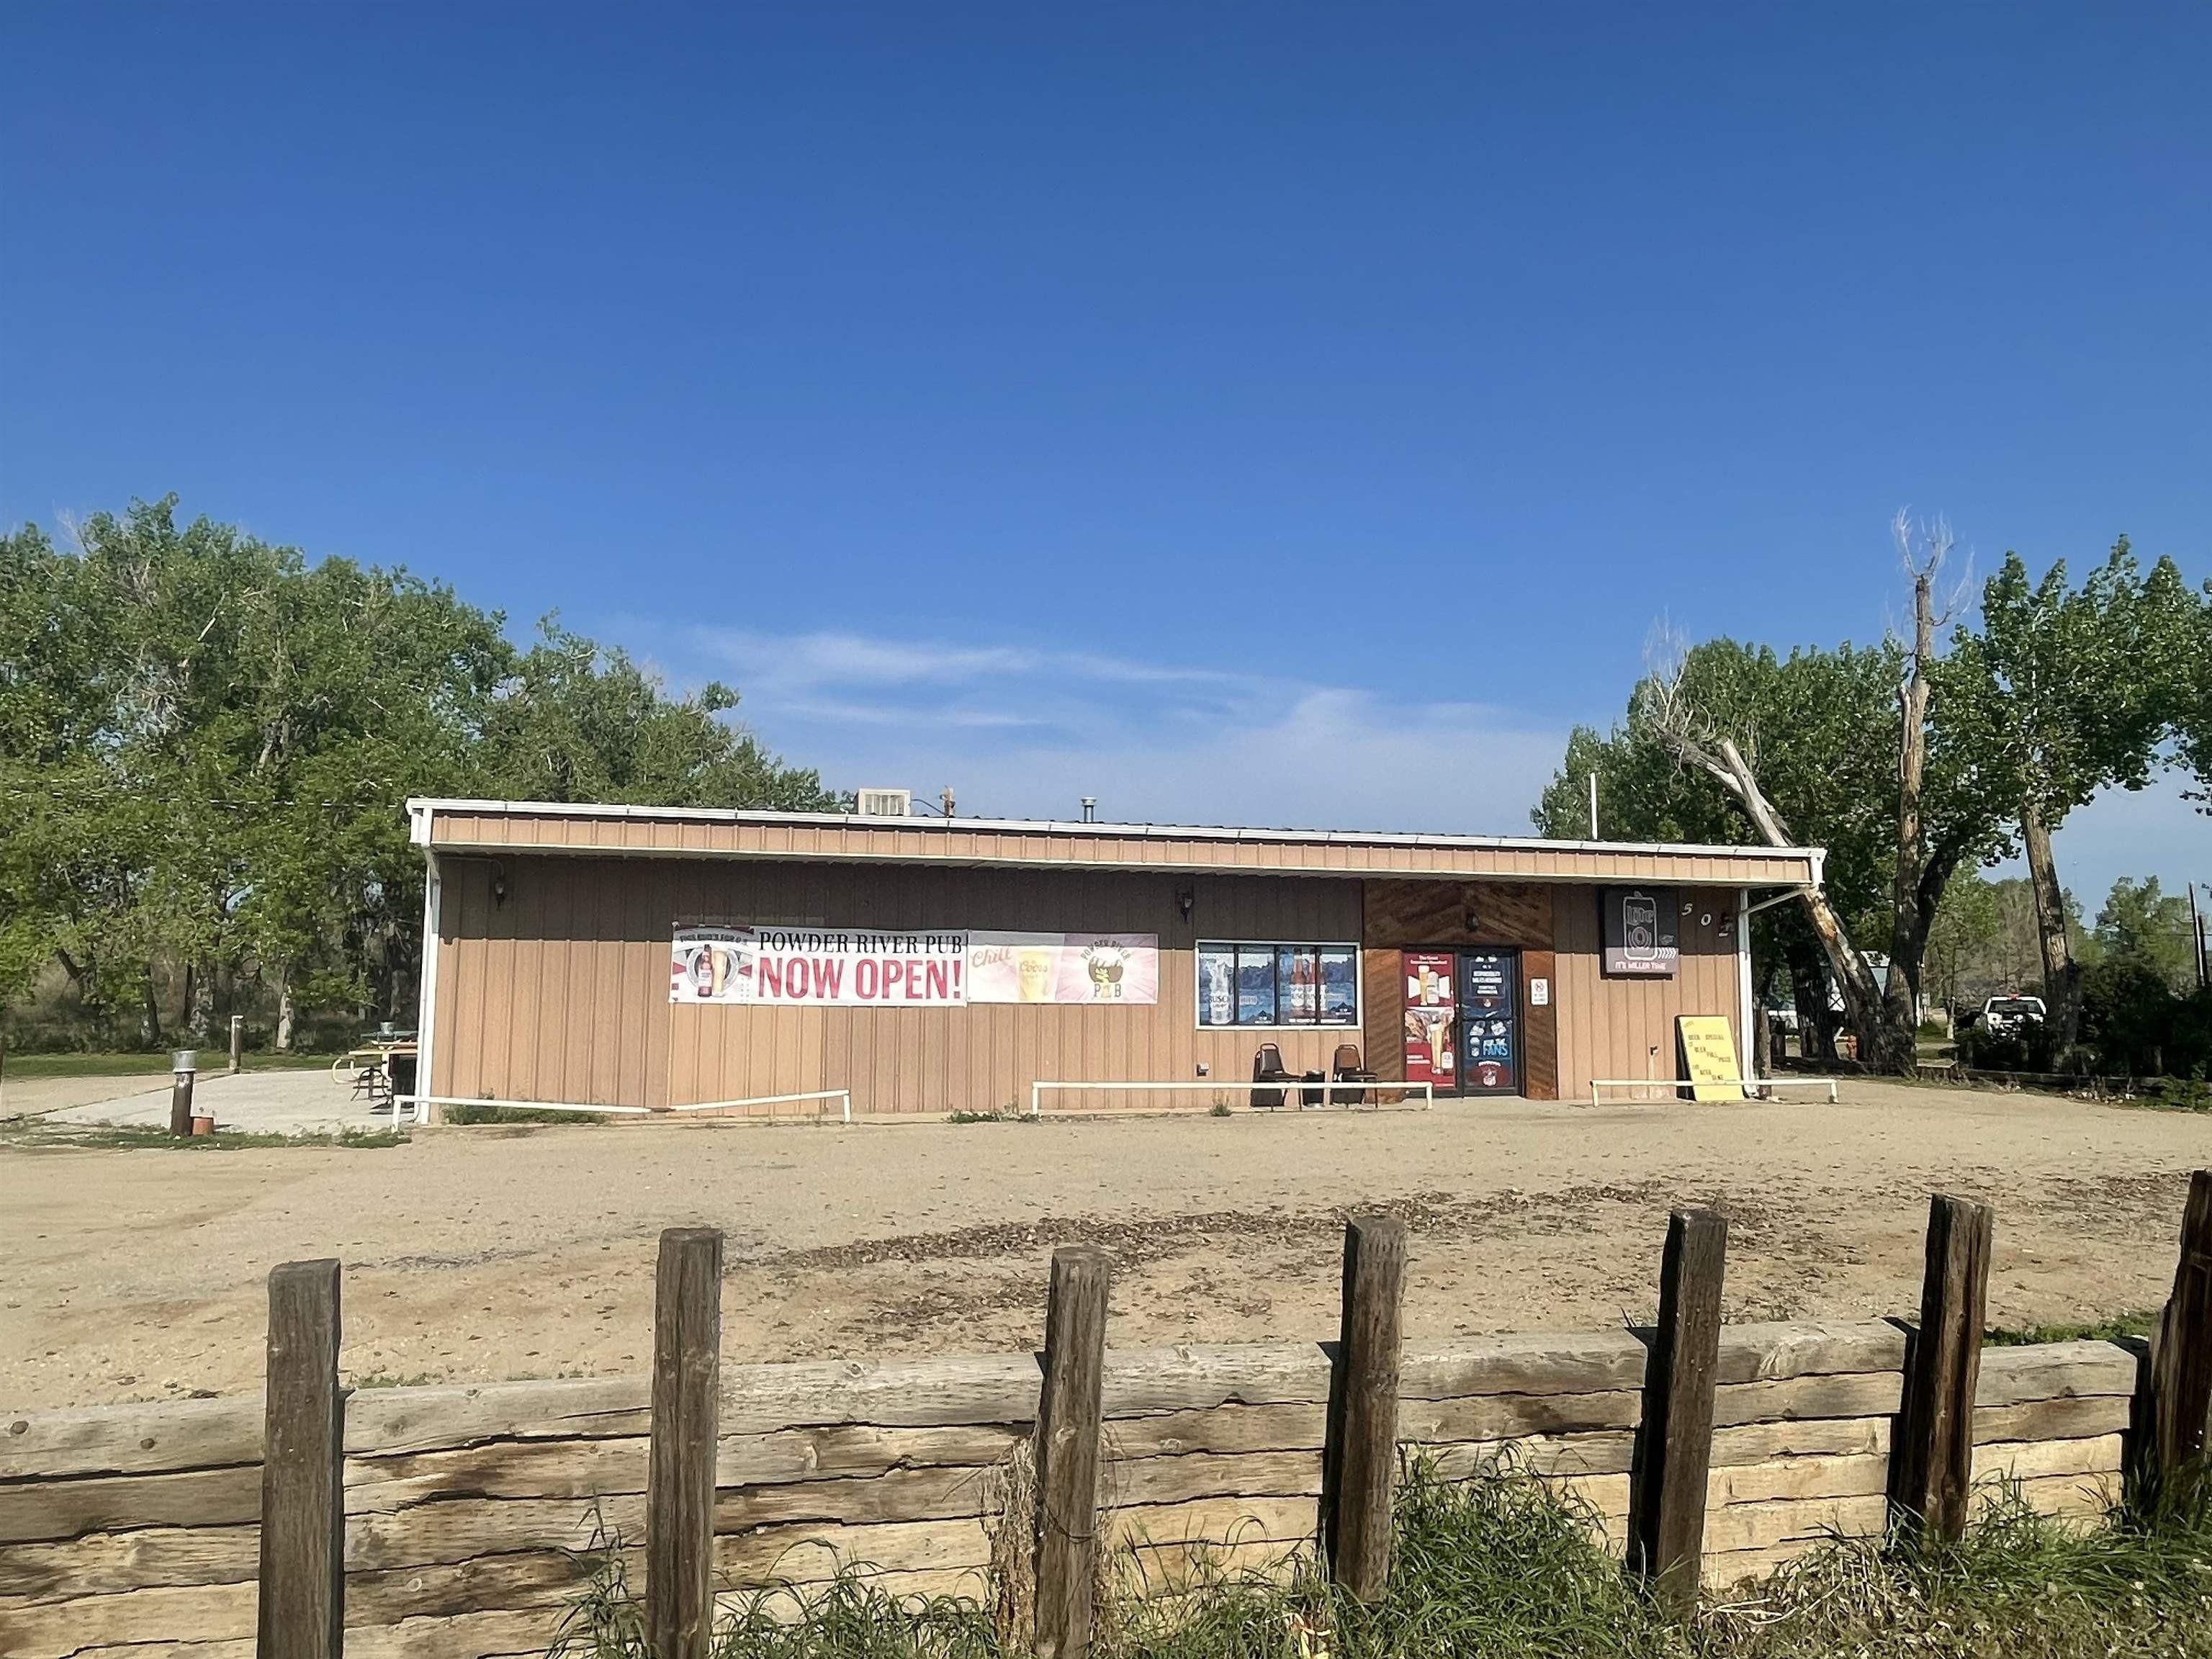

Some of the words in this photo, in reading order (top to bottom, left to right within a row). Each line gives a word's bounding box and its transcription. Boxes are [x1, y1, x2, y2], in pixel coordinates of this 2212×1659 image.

[759, 932, 849, 953] POWDER
[855, 934, 918, 953] RIVER
[925, 935, 961, 953] PUB
[971, 948, 1012, 968] Chill
[759, 957, 845, 999] NOW
[855, 958, 961, 999] OPEN!
[1094, 984, 1122, 998] PB
